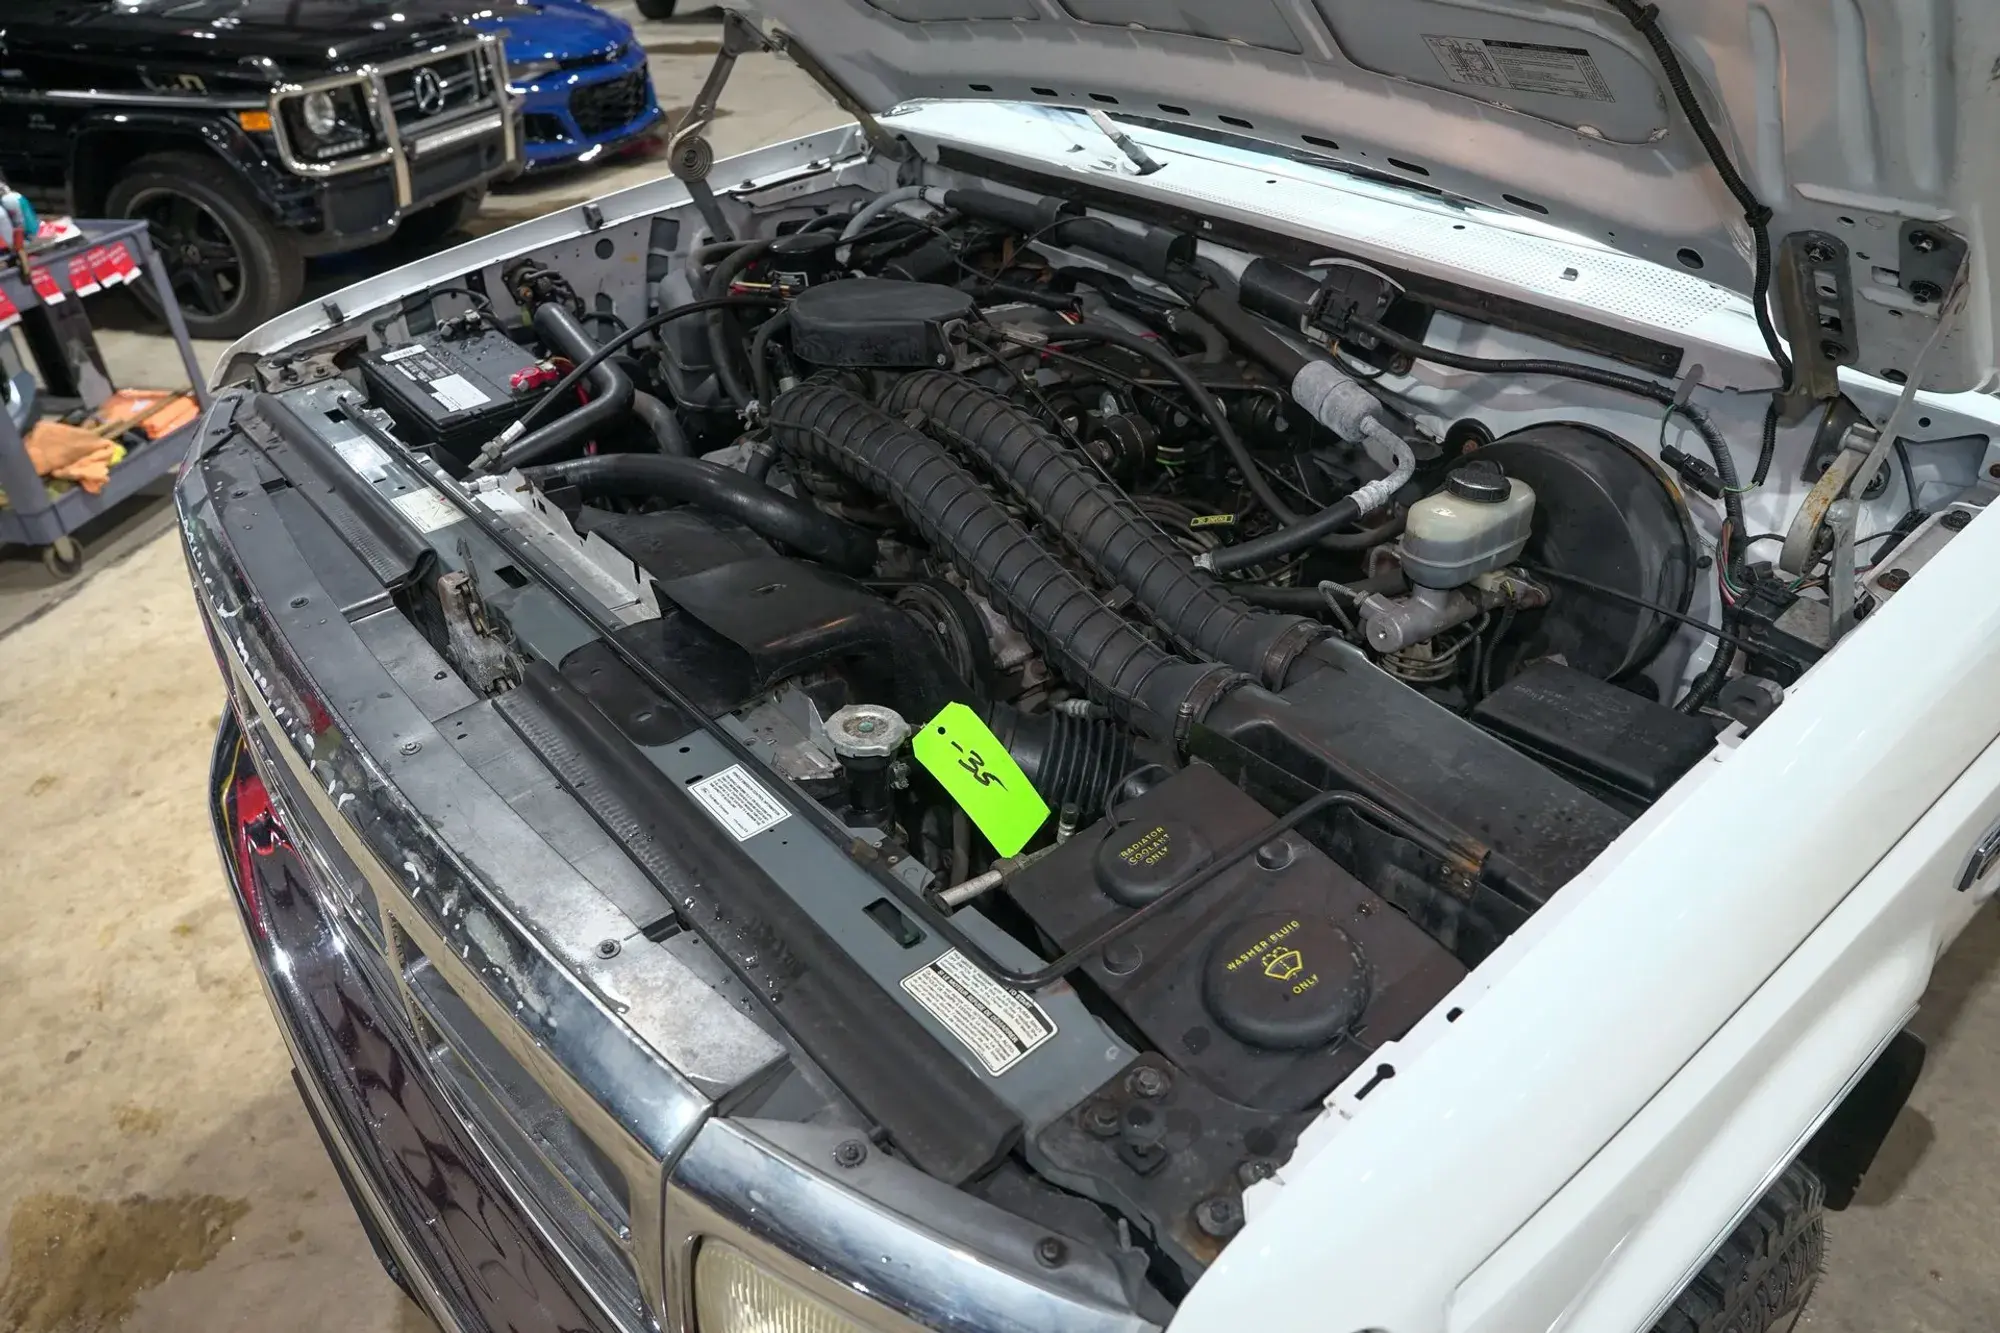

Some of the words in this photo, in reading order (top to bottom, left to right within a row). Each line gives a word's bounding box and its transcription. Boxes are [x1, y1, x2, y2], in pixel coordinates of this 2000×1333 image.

[1120, 827, 1164, 859] RADIATOR
[1128, 834, 1169, 864] COOLANT
[1145, 846, 1168, 865] ONLY
[1226, 940, 1269, 972] WASHER
[1268, 920, 1301, 944] FLUID
[947, 978, 969, 996] MOTEUR
[965, 994, 986, 1011] REFUSE
[982, 1008, 992, 1017] DE
[1292, 973, 1319, 994] ONLY
[1015, 993, 1033, 1009] START
